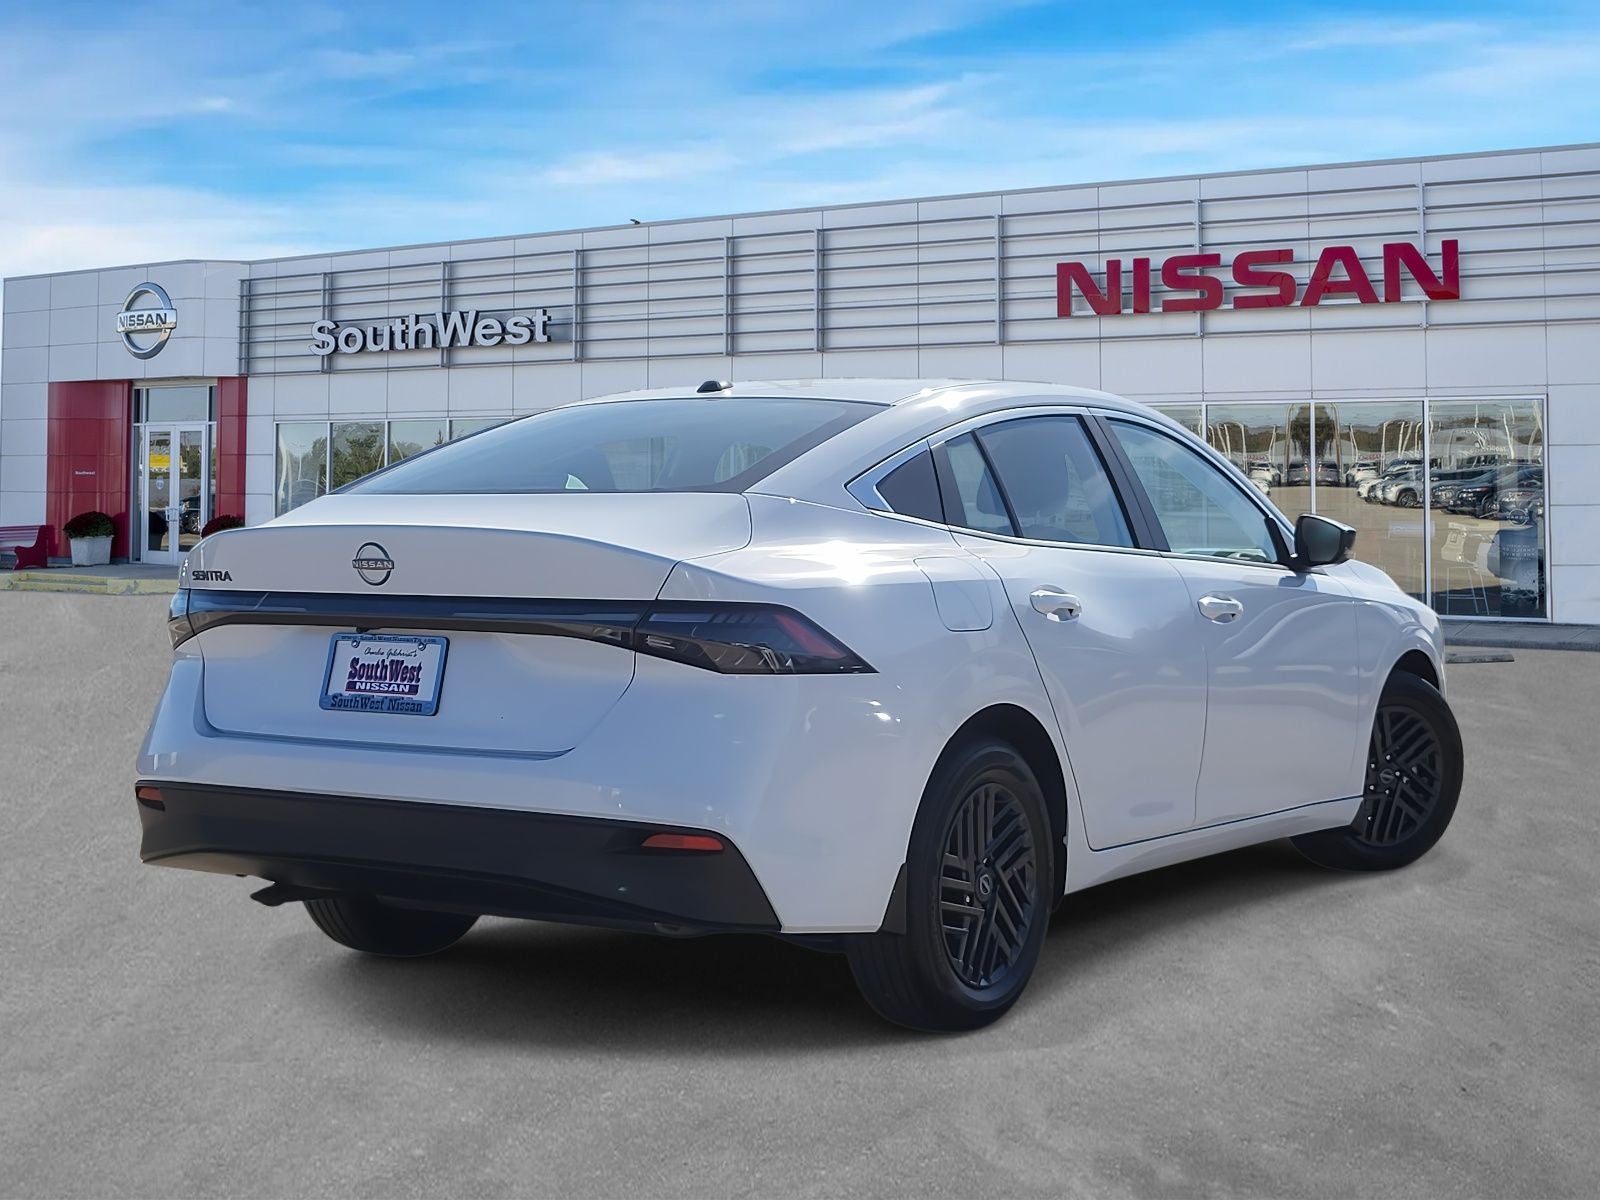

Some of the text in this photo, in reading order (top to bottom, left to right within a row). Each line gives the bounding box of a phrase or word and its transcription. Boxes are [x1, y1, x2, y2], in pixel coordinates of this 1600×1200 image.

[1057, 239, 1460, 319] NISSAN
[119, 312, 167, 329] NISSAN
[309, 308, 551, 356] SouthWest
[352, 560, 393, 569] NISSAN
[192, 570, 233, 582] SENTRA
[348, 657, 423, 684] SouthWest
[355, 682, 410, 693] NISSAN
[330, 694, 423, 713] SouthWest Nissan
